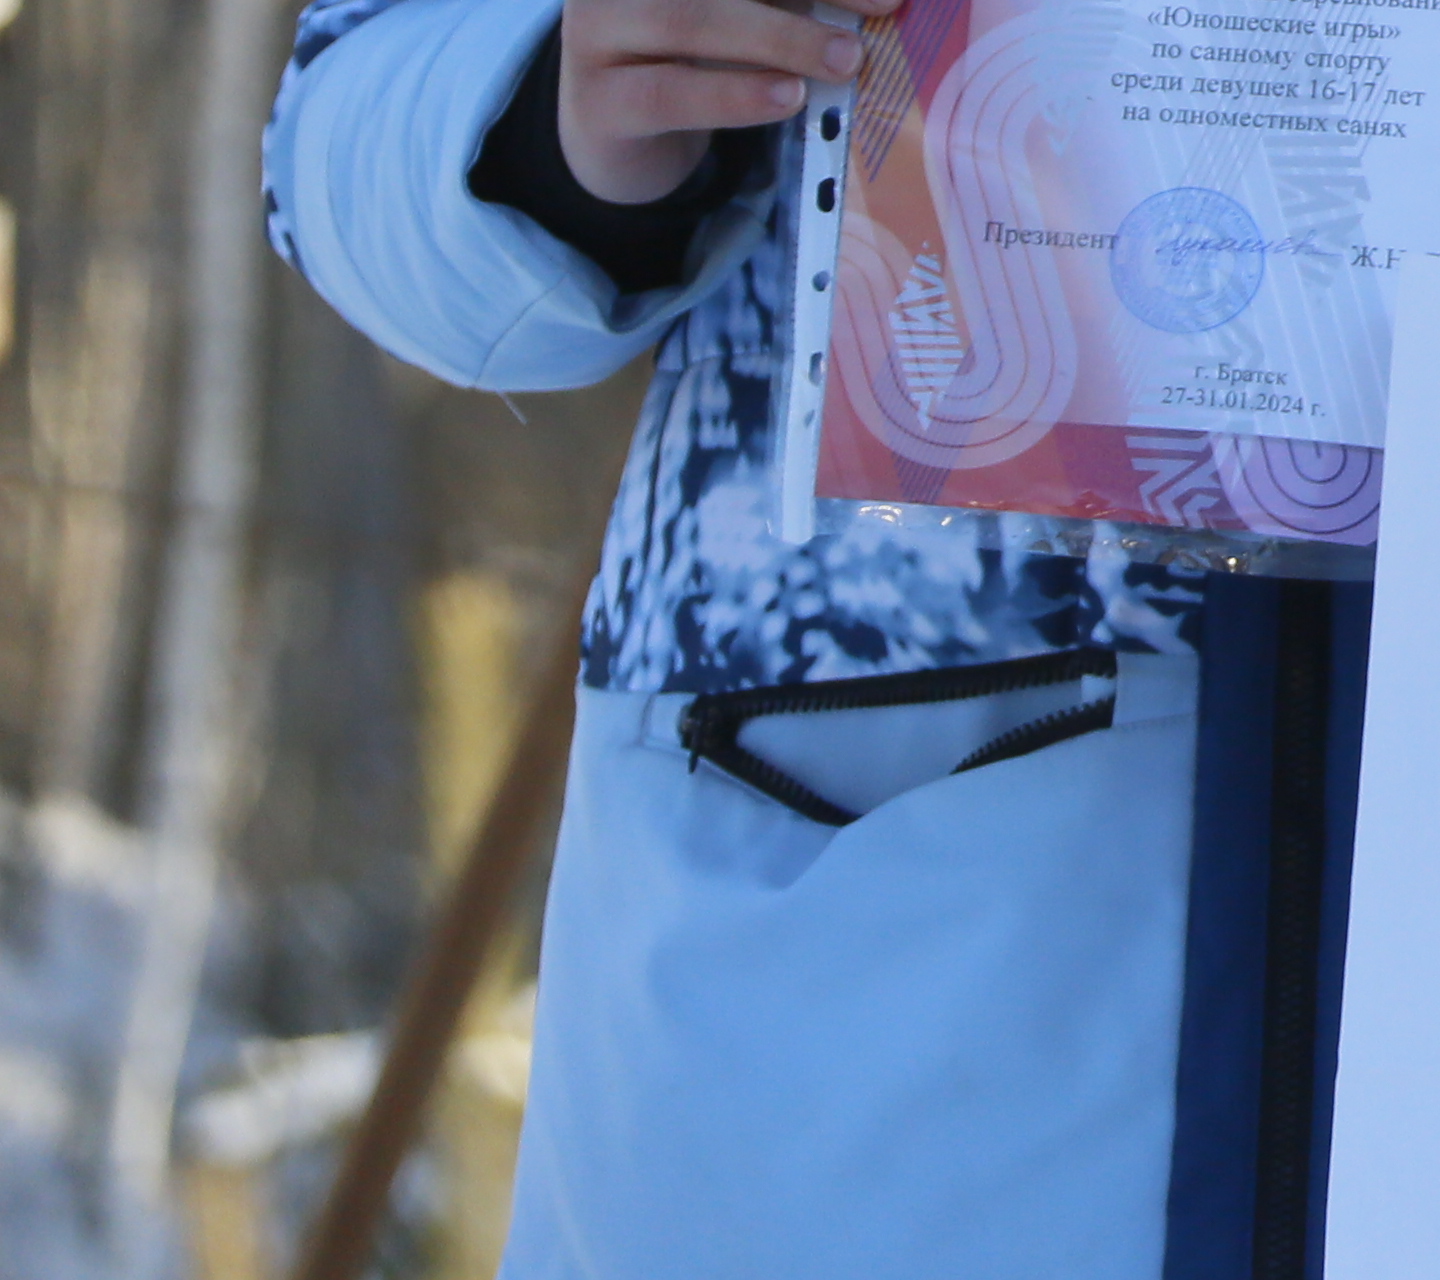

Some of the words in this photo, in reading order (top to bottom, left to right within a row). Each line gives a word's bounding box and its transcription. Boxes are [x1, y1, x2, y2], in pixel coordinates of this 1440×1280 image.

[1147, 6, 1315, 35] «Юношеские
[1324, 21, 1399, 43] игры»
[1151, 42, 1182, 58] по
[1190, 45, 1295, 70] санному
[1304, 52, 1390, 76] спорту
[1110, 72, 1182, 93] среди
[1190, 77, 1298, 100] девушек
[1310, 79, 1376, 104] 16-17
[1383, 89, 1425, 106] лет
[1122, 105, 1150, 120] на
[1158, 107, 1328, 132] одноместных
[1336, 117, 1405, 137] санях
[983, 219, 1119, 252] Президент
[1217, 362, 1287, 386] Братск
[1161, 386, 1303, 414] 27-31.01.2024
